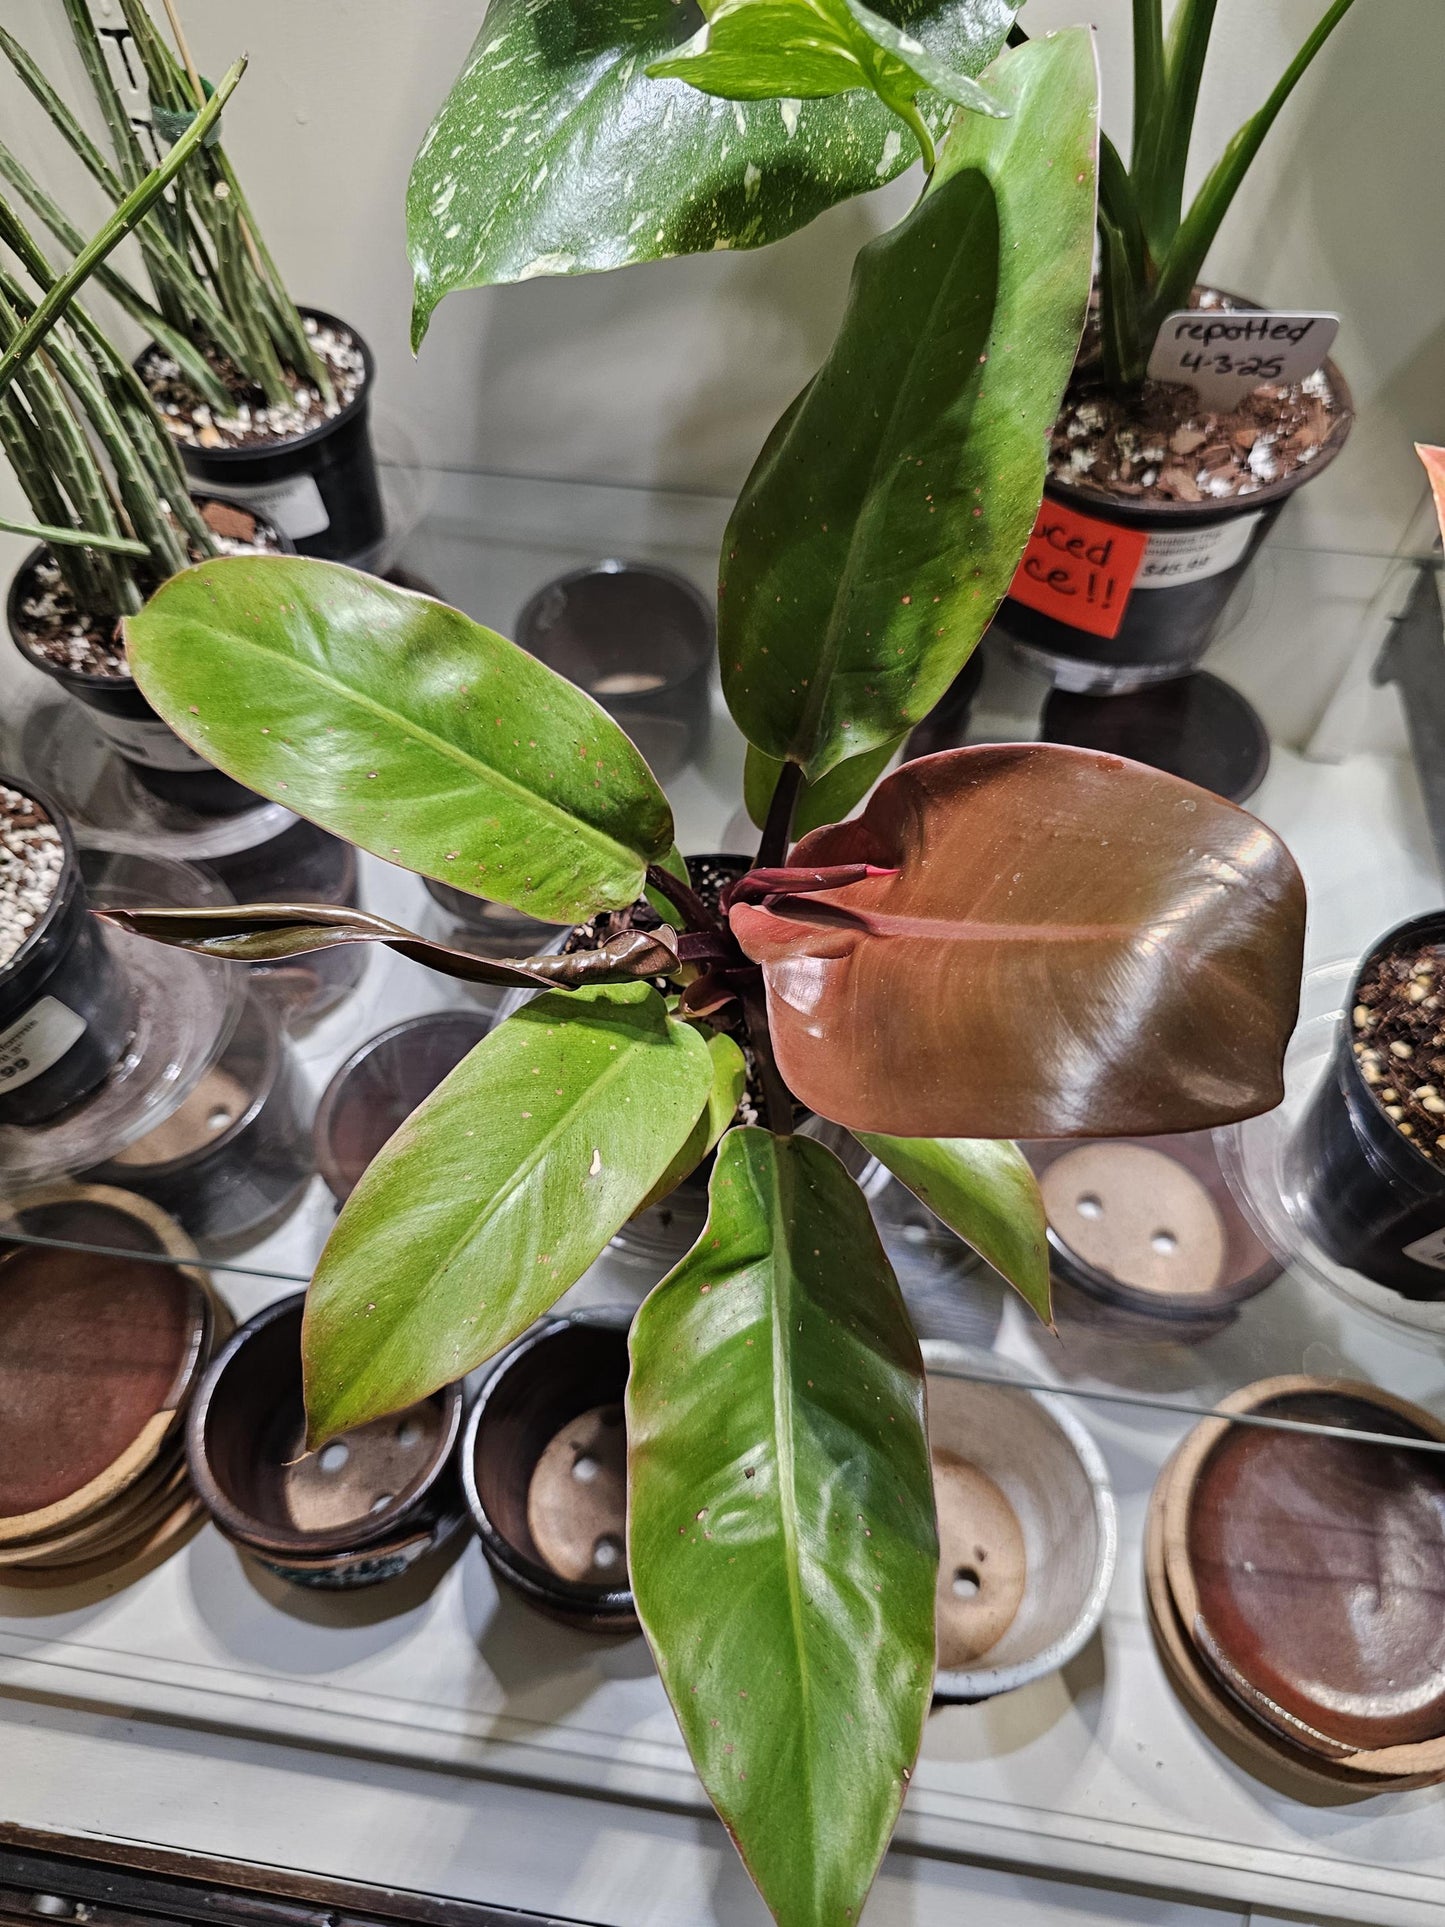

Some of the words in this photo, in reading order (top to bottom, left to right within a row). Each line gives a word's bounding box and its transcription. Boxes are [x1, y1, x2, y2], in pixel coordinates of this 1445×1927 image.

[1174, 319, 1315, 347] repotted
[1179, 352, 1284, 378] 4-3-25
[1033, 523, 1113, 568] uced
[1024, 555, 1115, 609] ce!!
